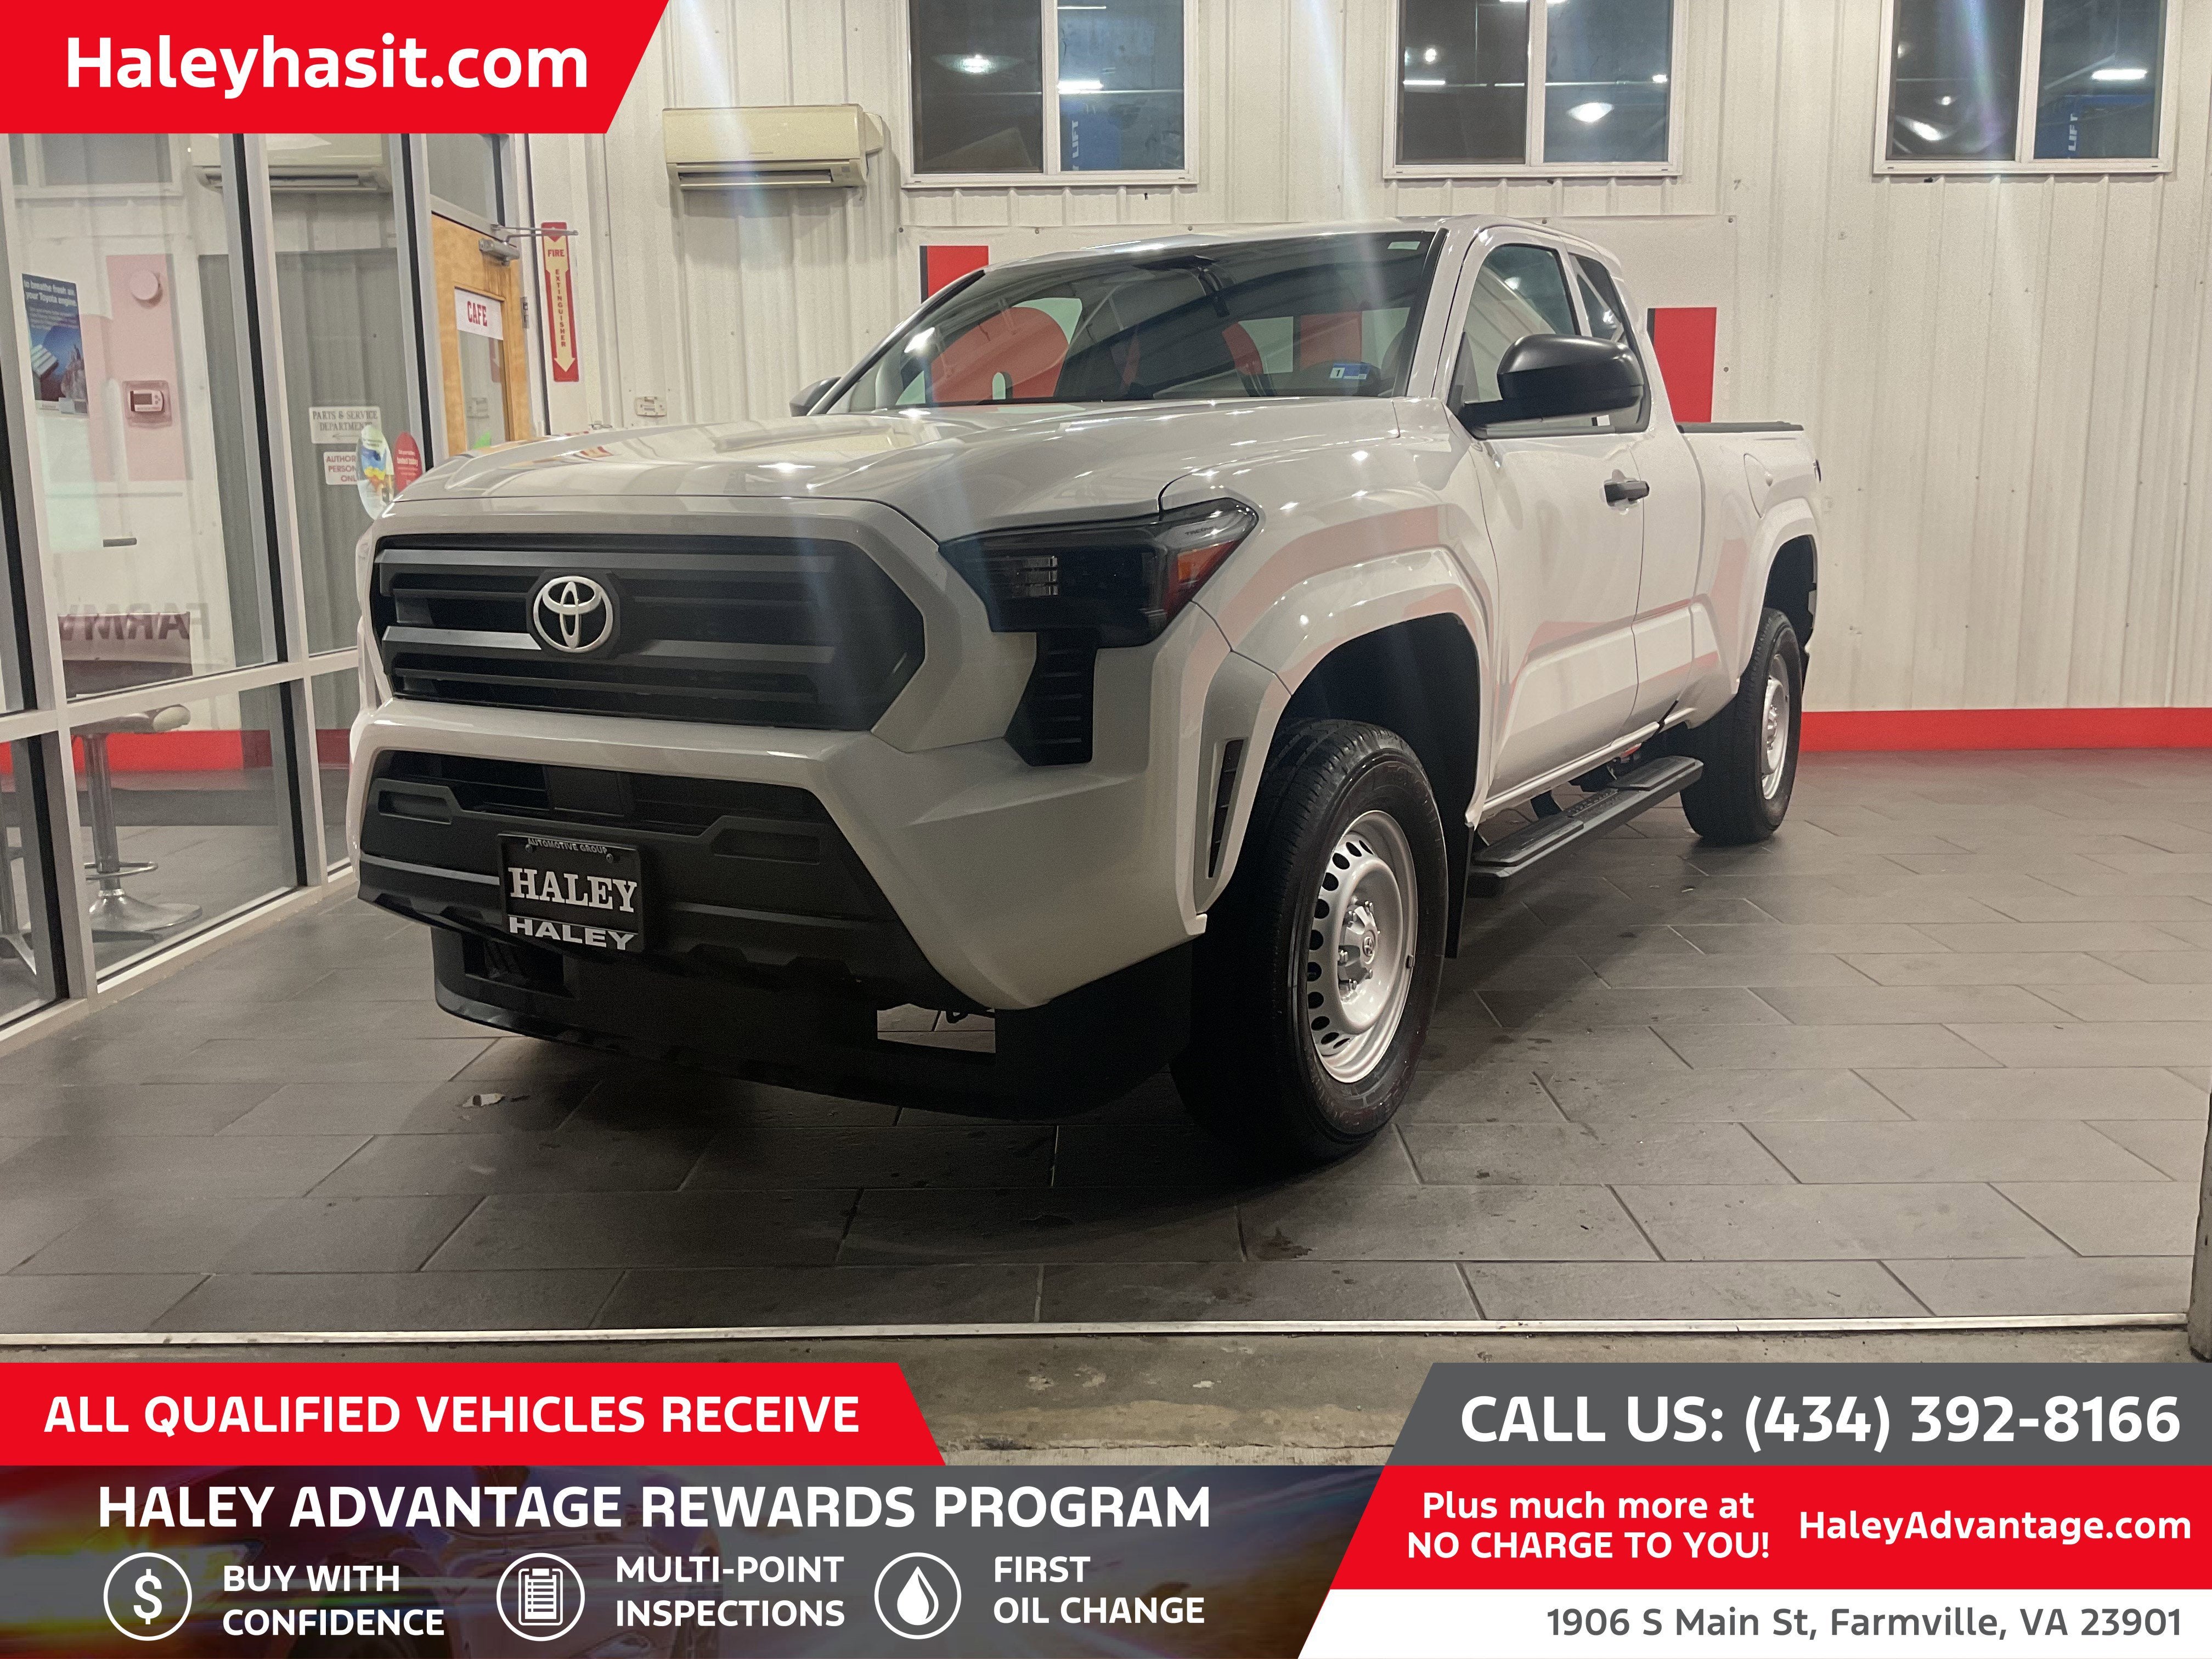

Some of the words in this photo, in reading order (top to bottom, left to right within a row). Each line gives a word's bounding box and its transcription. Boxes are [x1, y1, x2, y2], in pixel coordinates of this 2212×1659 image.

[2067, 113, 2078, 151] LIFT
[548, 249, 565, 257] FIRE
[467, 301, 488, 327] CAFE
[555, 269, 566, 347] EXTINGUISHER
[312, 410, 336, 420] PARTS
[338, 410, 344, 419] &
[346, 410, 378, 419] SERVICE
[528, 838, 579, 851] AUTOMOTIVE
[580, 844, 607, 854] GROUP
[508, 867, 637, 913] HALEY
[509, 916, 634, 950] HALEY
